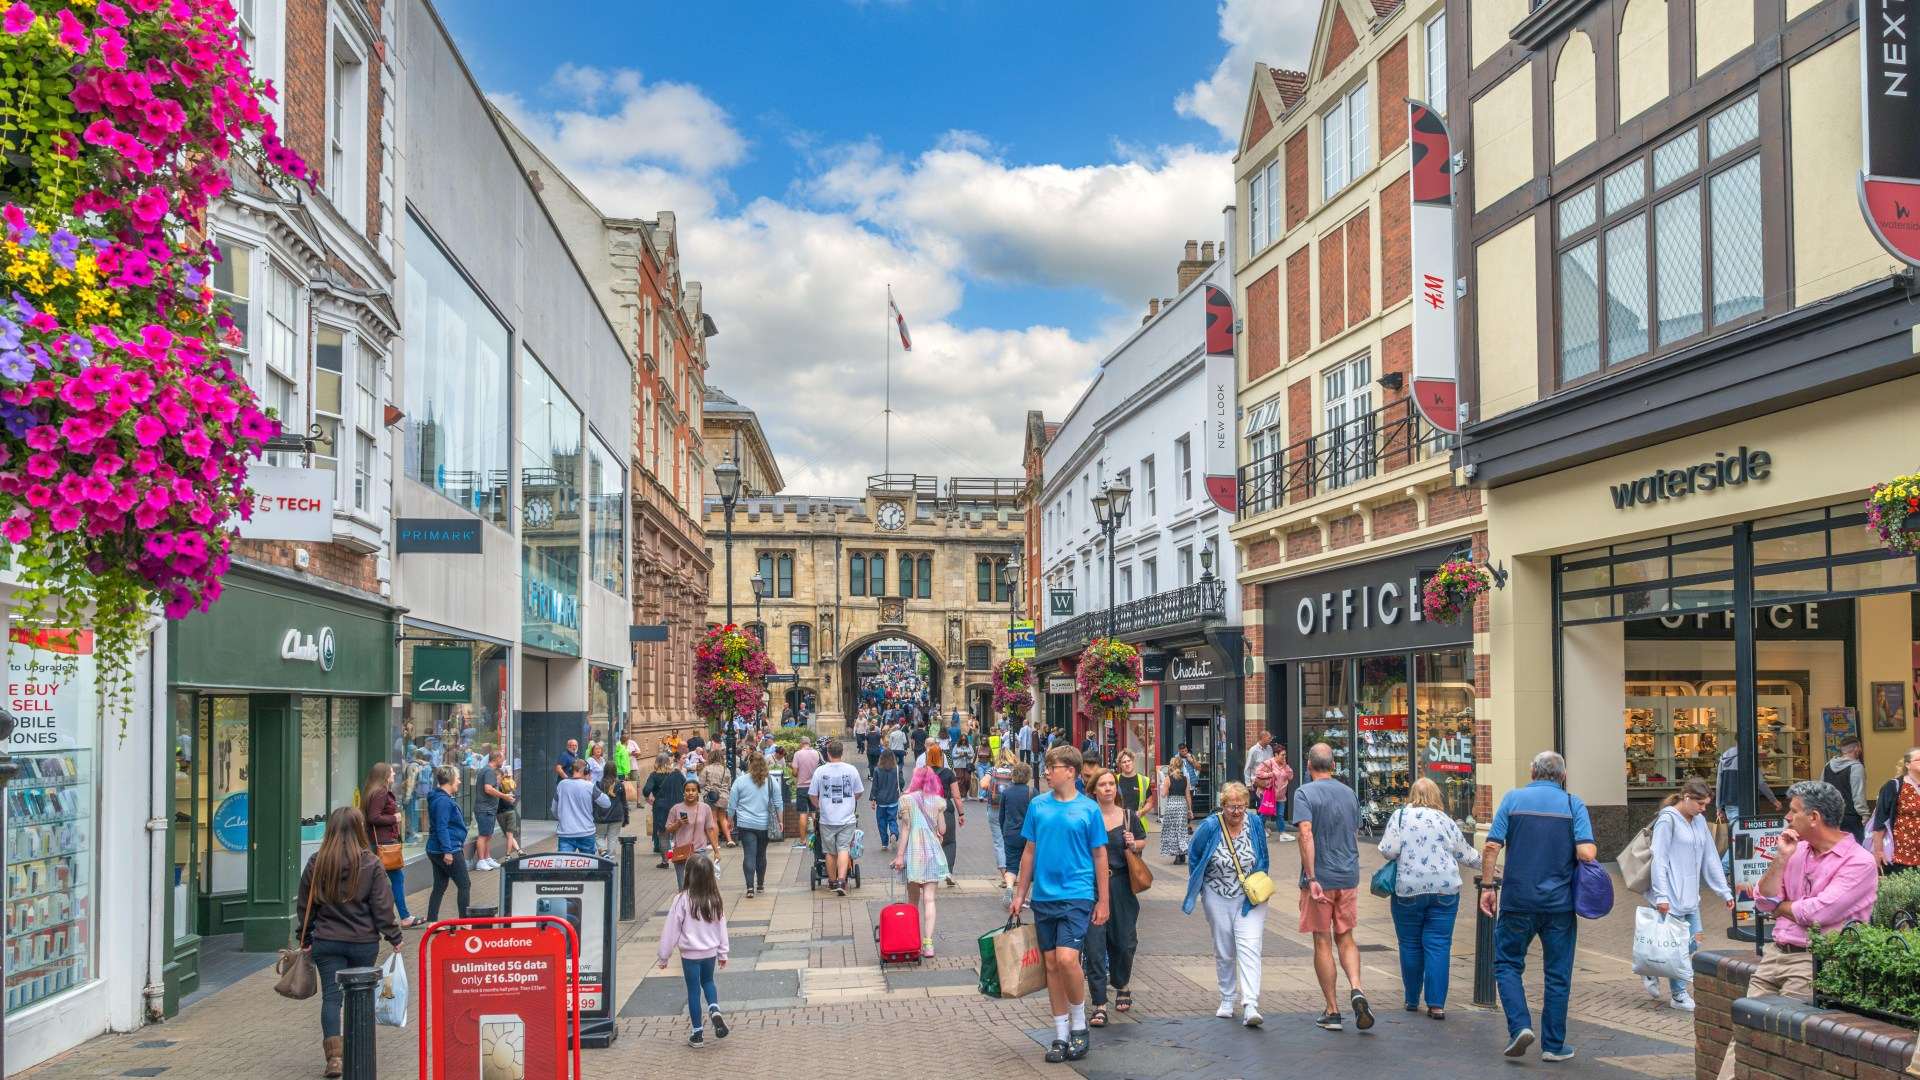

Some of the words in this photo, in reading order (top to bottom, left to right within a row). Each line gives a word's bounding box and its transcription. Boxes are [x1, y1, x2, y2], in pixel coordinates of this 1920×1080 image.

[1424, 273, 1445, 309] H&M
[1217, 384, 1225, 415] LOOK
[1217, 420, 1225, 448] NEW
[1609, 445, 1772, 510] waterside
[276, 496, 321, 512] TECH
[1055, 595, 1071, 609] W
[1297, 577, 1421, 635] OFFICE
[24, 684, 60, 696] BUY
[419, 678, 465, 692] Clarks
[12, 699, 54, 711] SELL
[1363, 717, 1385, 726] SALE
[1429, 735, 1473, 764] SALE
[527, 859, 553, 868] FONE
[564, 859, 591, 868] TECH
[484, 937, 533, 948] vodafone
[451, 962, 505, 973] Unlimited
[507, 961, 522, 971] 5G
[523, 960, 548, 970] data
[461, 975, 482, 986] only
[484, 972, 539, 984] £16.50pm
